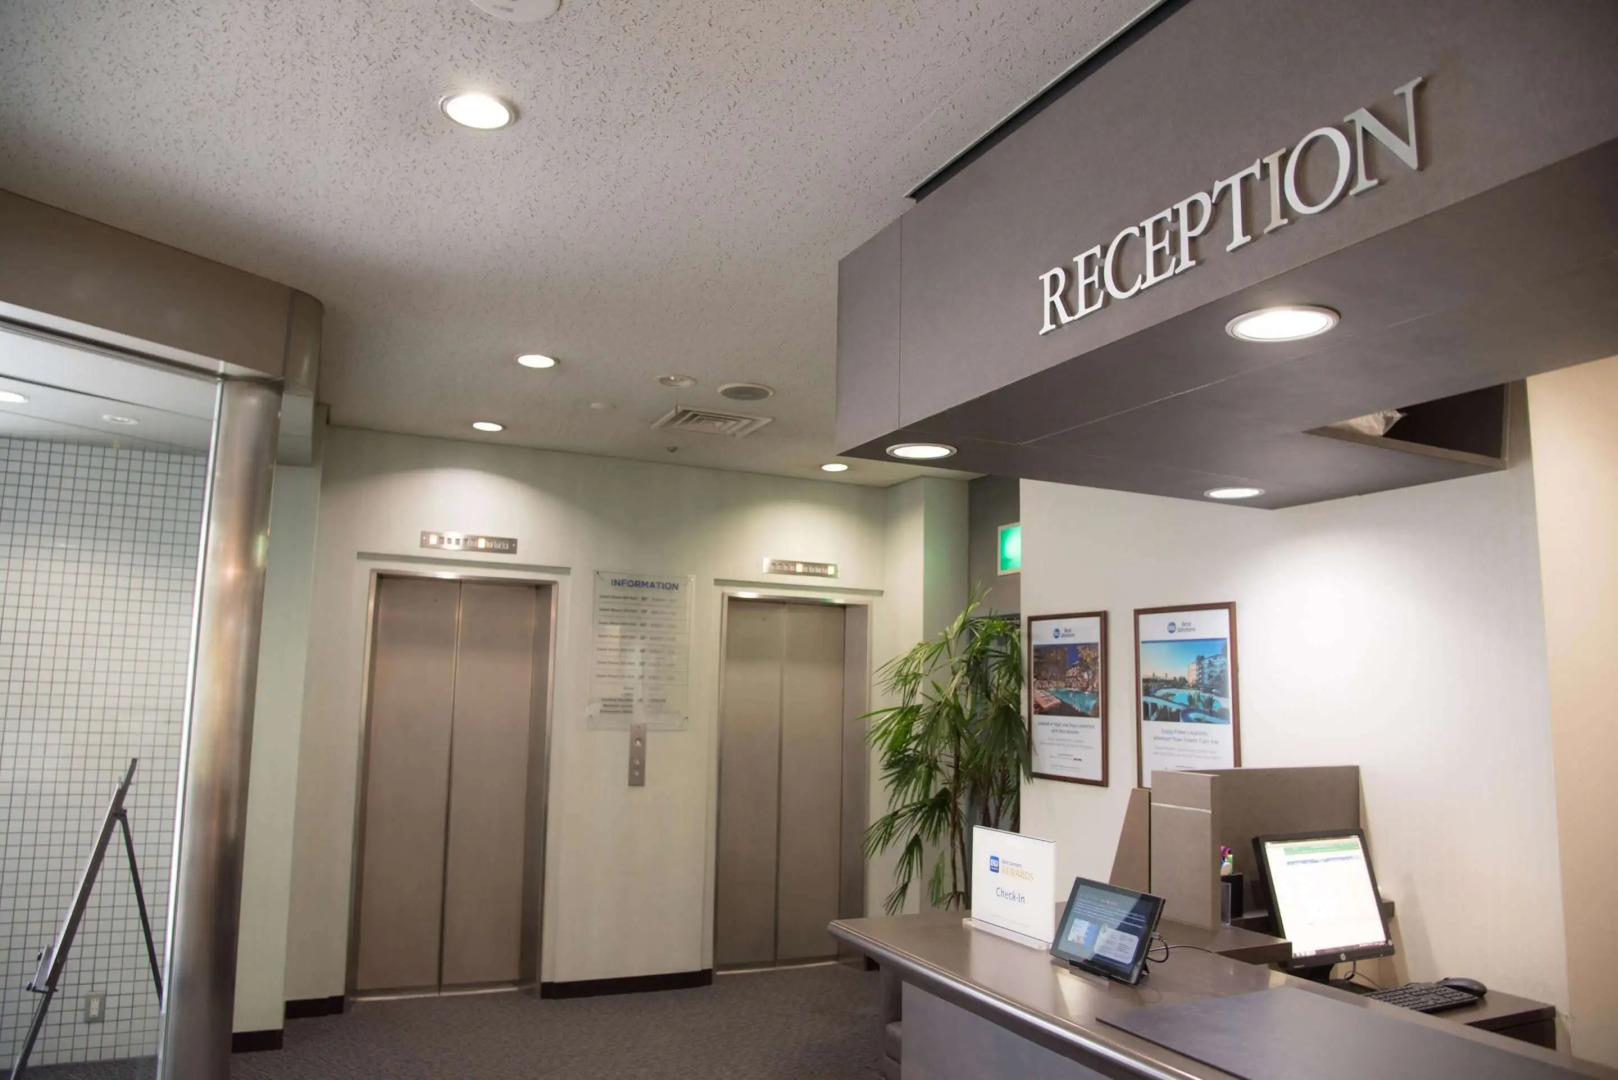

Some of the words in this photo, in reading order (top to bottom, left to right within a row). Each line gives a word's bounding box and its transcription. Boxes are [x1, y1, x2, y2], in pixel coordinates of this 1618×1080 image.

[1038, 76, 1423, 336] RECEPTION
[611, 578, 679, 591] INFORMATION
[1001, 865, 1034, 881] REWARDS
[995, 886, 1026, 904] Check-In
